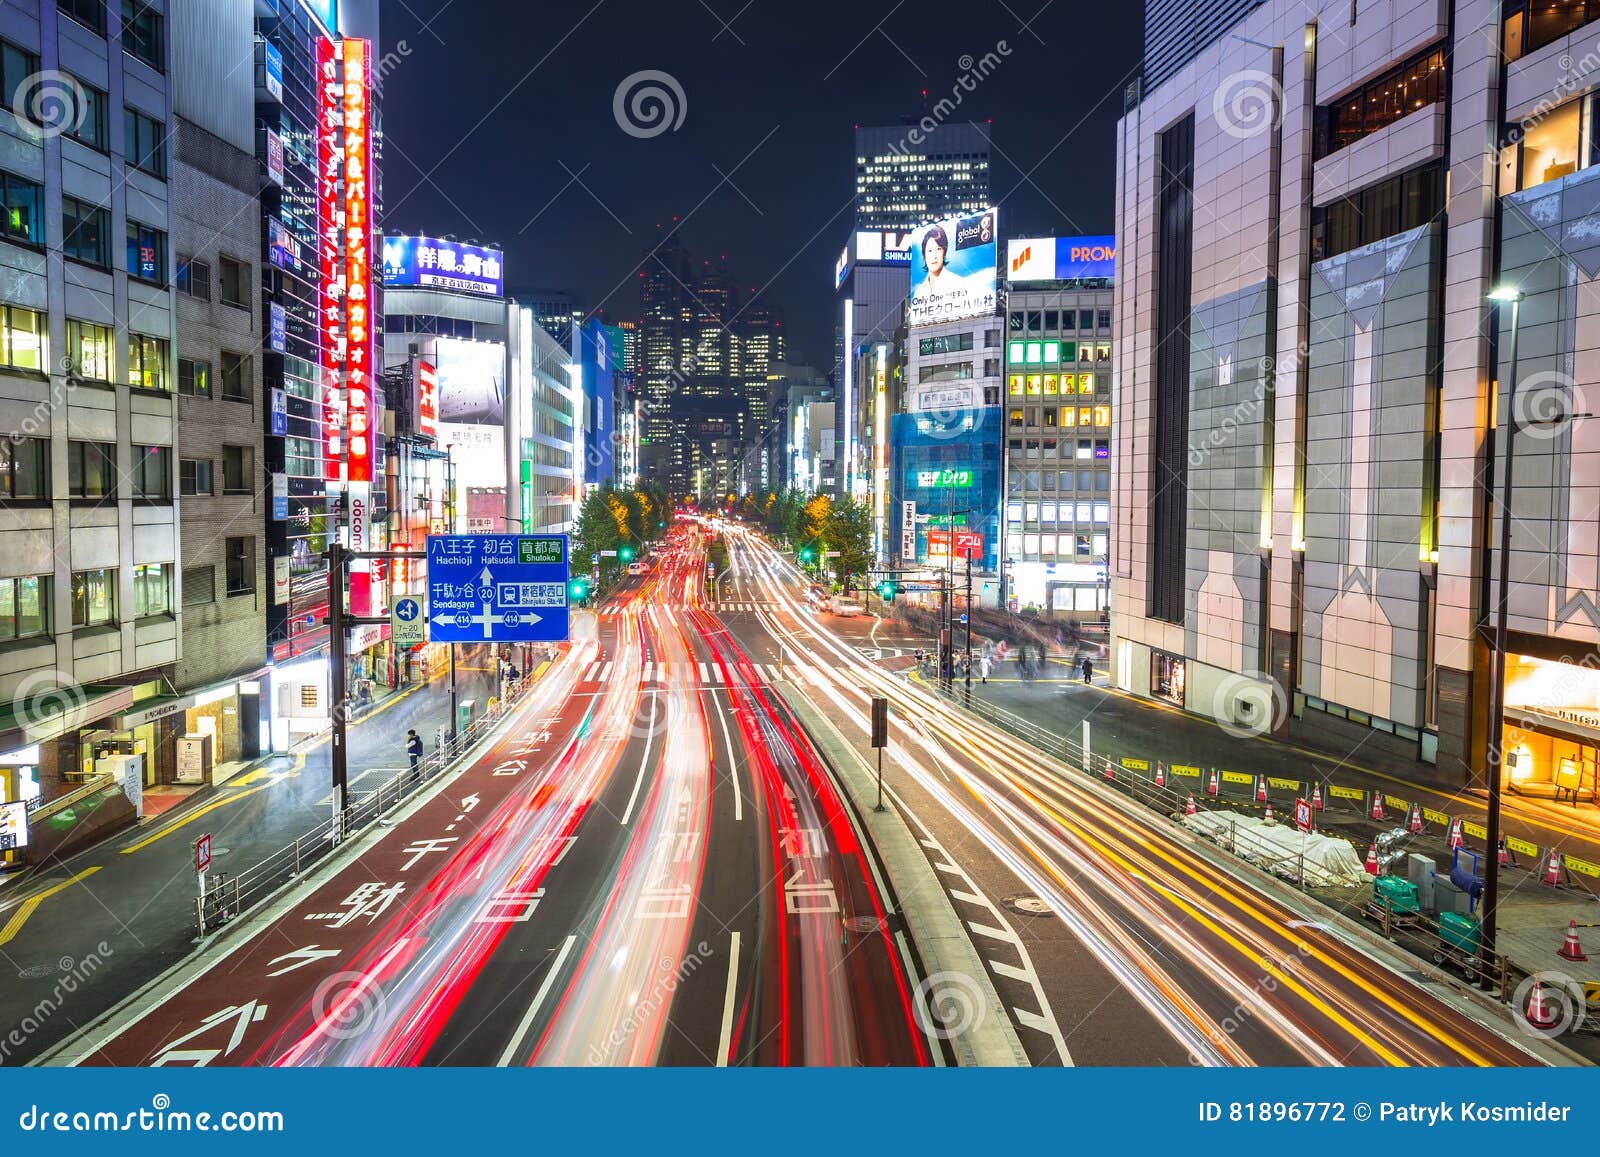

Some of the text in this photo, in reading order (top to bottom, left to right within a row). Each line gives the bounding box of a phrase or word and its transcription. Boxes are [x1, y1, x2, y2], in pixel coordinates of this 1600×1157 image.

[958, 224, 980, 243] global
[417, 246, 500, 279] 洋服の青山
[885, 252, 912, 261] SHINJU
[431, 276, 489, 291] 京王百貨店向い
[912, 296, 928, 306] Only
[432, 539, 560, 554] 八王子 初台 首都高
[957, 535, 981, 546] アコム
[436, 554, 556, 566] Hachioji Hatsudai Shutoko
[432, 583, 475, 598] 千駄ヶ谷
[482, 589, 493, 598] 20
[521, 585, 564, 597] 新宿駅西口
[433, 601, 475, 609] Sendagaya
